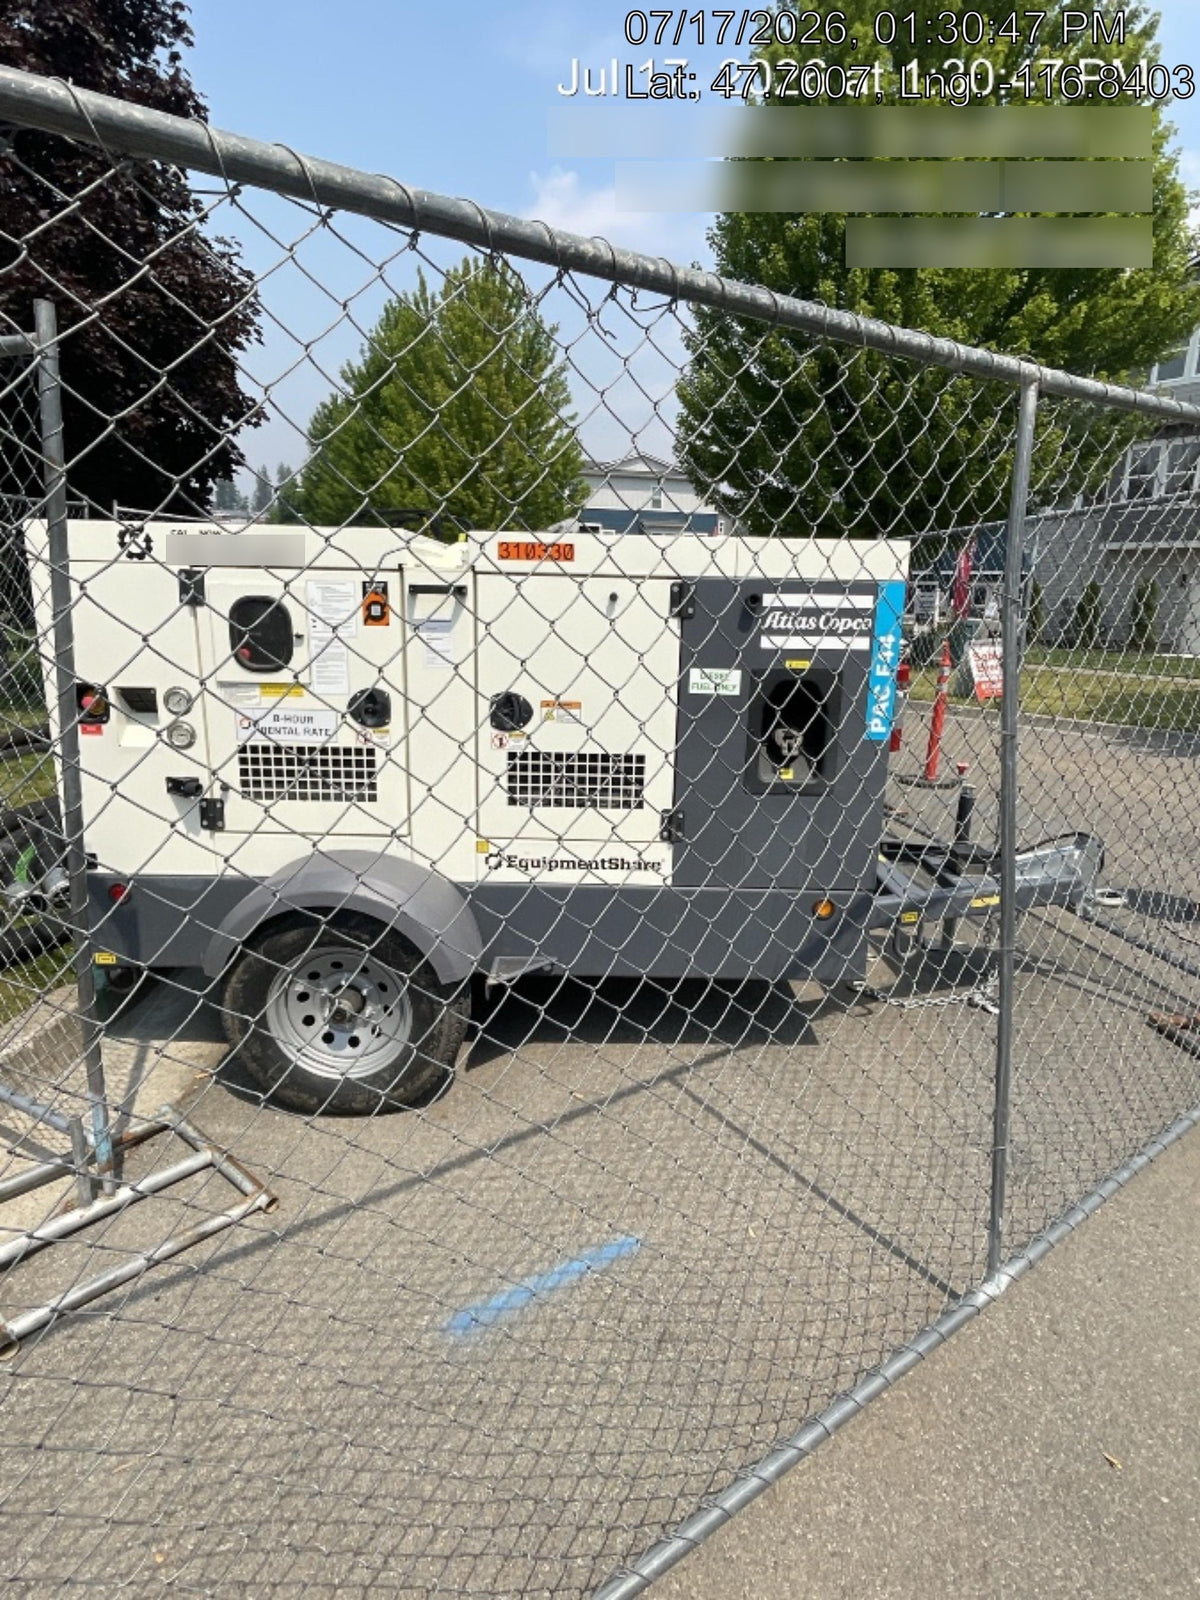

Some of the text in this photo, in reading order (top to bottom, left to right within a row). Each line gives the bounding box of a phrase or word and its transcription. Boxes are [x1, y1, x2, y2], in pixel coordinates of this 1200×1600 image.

[762, 609, 872, 633] Atlas Copco
[870, 684, 891, 733] PAC
[303, 727, 332, 737] RATE
[506, 854, 663, 871] EquipmentShare
